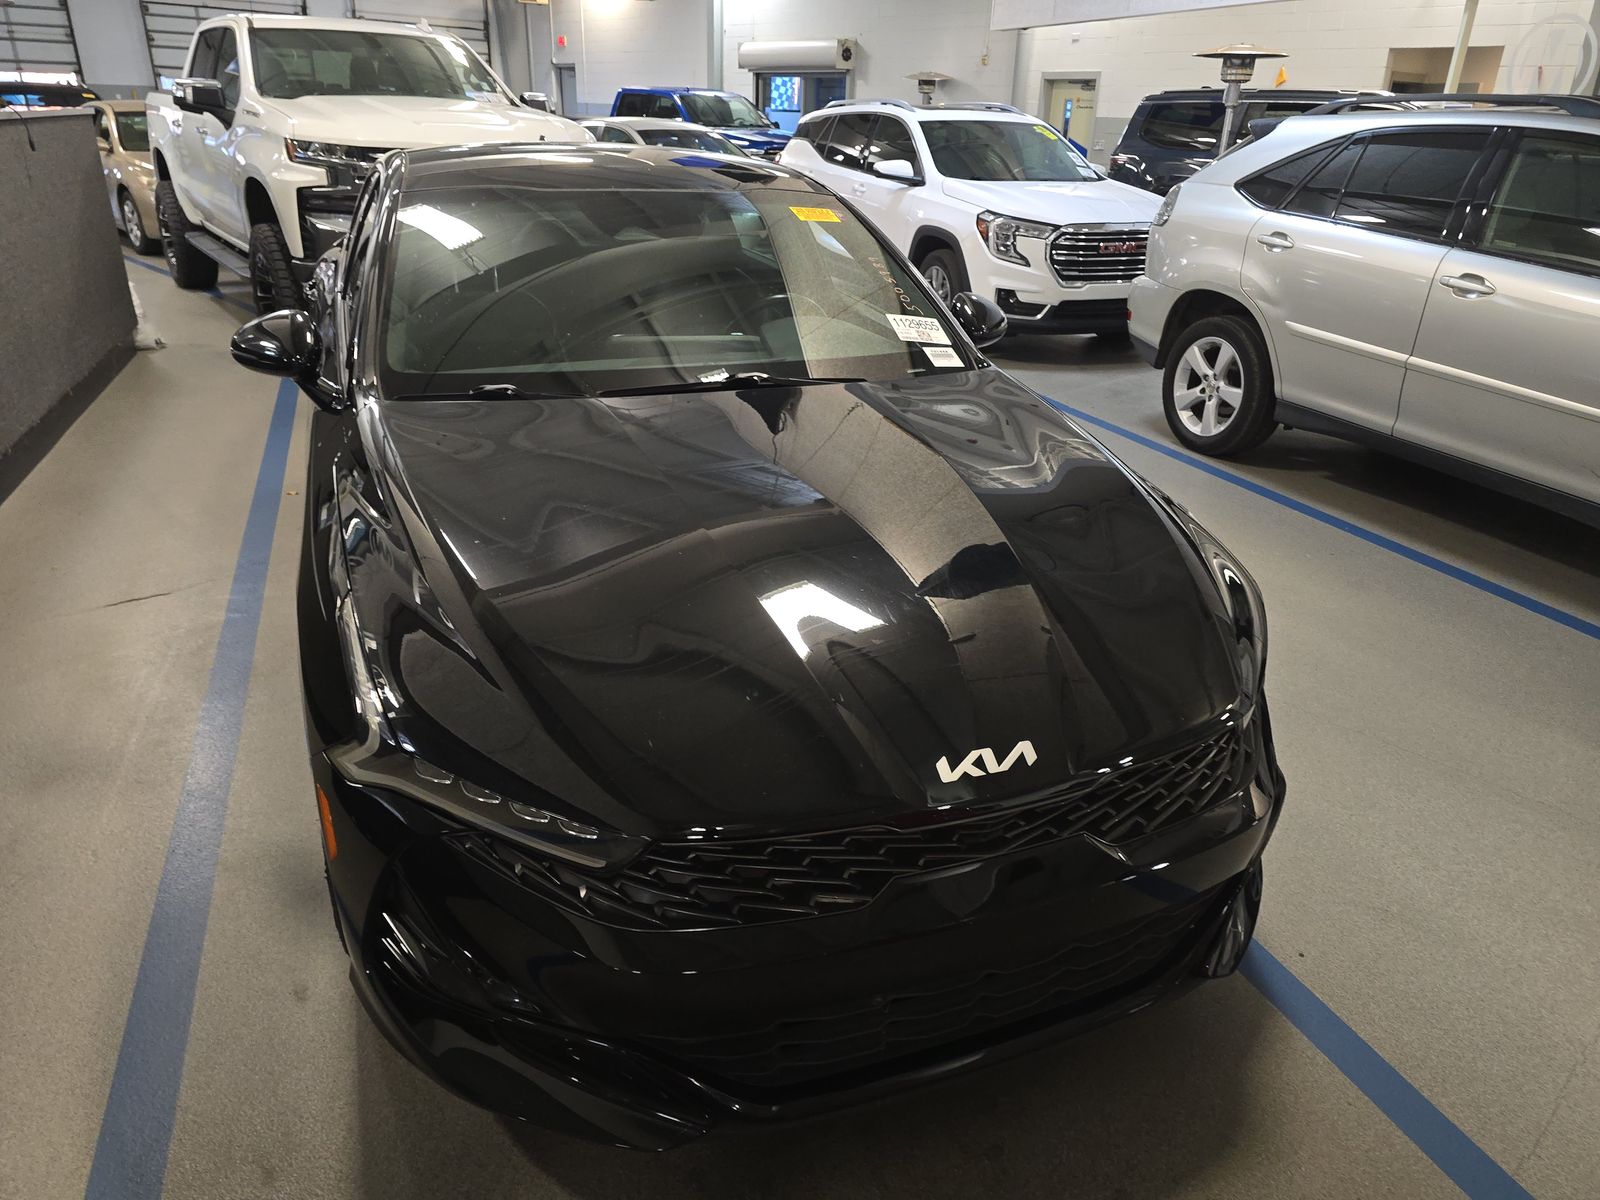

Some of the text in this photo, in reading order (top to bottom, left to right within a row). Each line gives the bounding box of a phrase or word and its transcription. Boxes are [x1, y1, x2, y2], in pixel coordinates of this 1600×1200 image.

[1099, 241, 1146, 254] GMC
[893, 317, 940, 332] 1129655
[935, 740, 1038, 784] KIA
